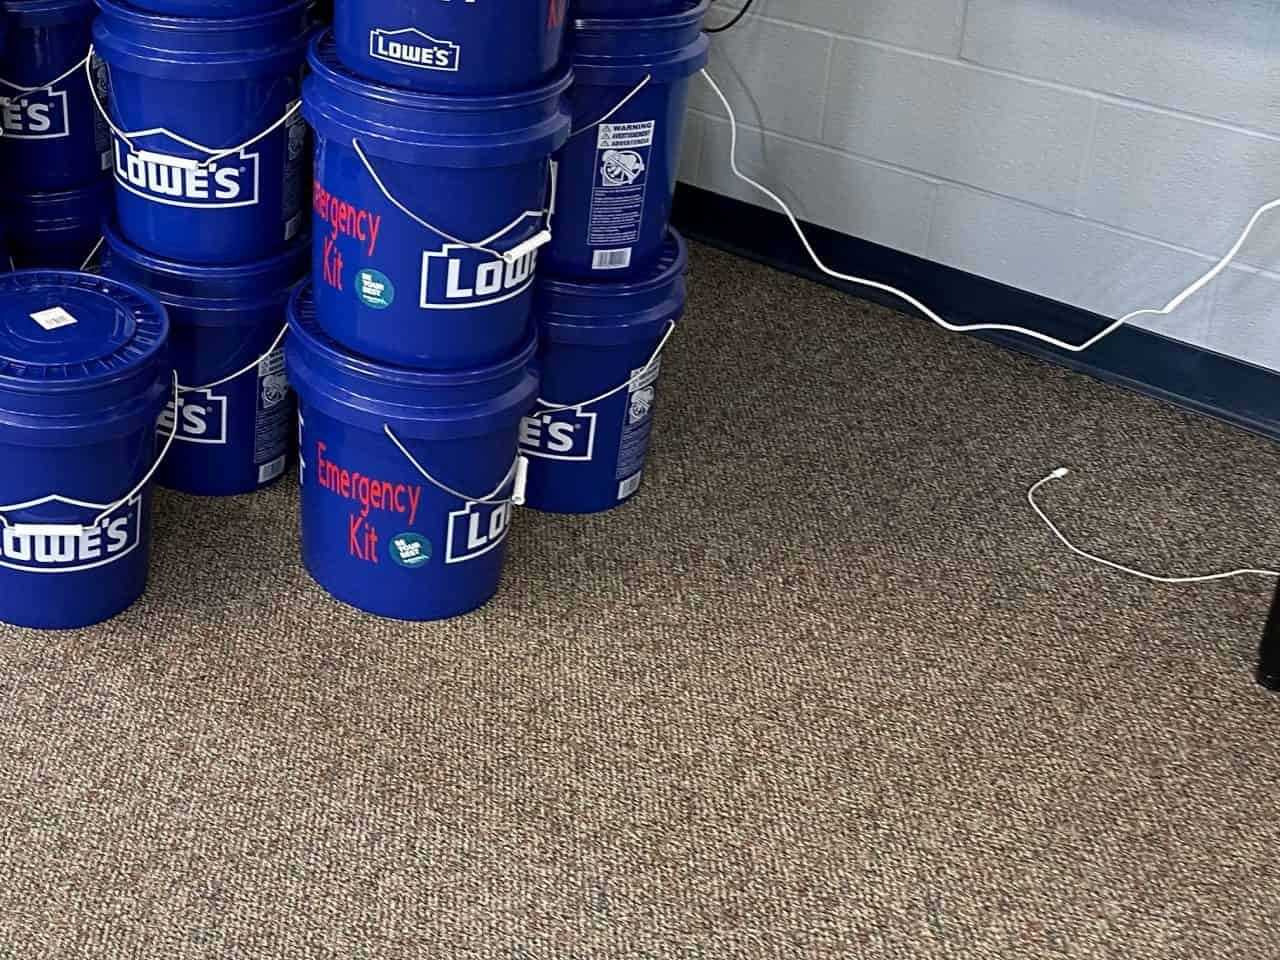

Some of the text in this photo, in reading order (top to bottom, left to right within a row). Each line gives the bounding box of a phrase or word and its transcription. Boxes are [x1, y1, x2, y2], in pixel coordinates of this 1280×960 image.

[378, 35, 450, 66] LOWE'S
[115, 137, 241, 200] LOWE'S
[323, 236, 343, 291] Kit
[317, 441, 422, 525] Emergency
[349, 514, 379, 564] Kit
